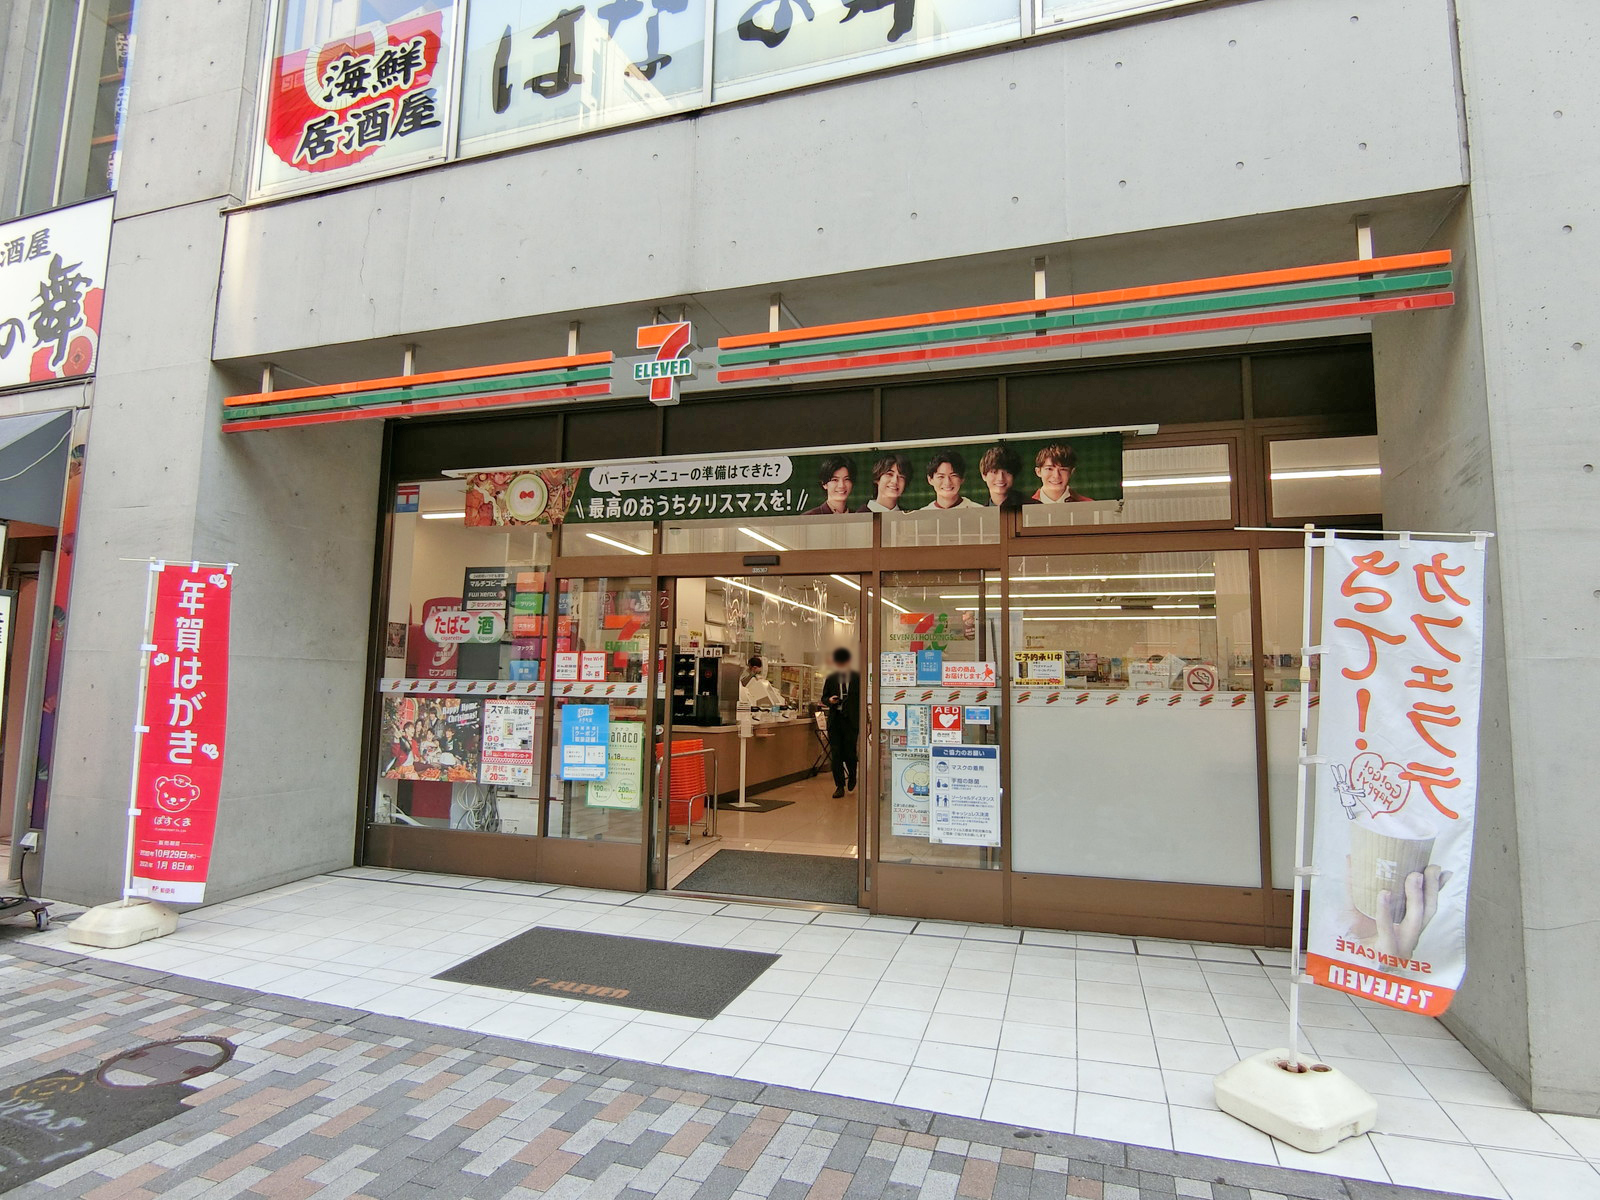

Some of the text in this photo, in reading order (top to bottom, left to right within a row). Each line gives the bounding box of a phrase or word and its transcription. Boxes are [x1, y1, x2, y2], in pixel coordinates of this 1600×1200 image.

[322, 36, 425, 102] 海鮮
[296, 88, 441, 160] 居酒屋
[589, 489, 792, 519] 最高のおうちクリスマスを!
[434, 616, 471, 635] たばこ
[477, 616, 494, 635] 酒
[1015, 653, 1063, 661] ご予約承り中
[169, 580, 207, 765] 年賀はがき
[935, 706, 960, 714] AED
[610, 731, 639, 744] anaco
[943, 749, 985, 757] ご協力のお願い
[154, 815, 191, 827] ぽすくま
